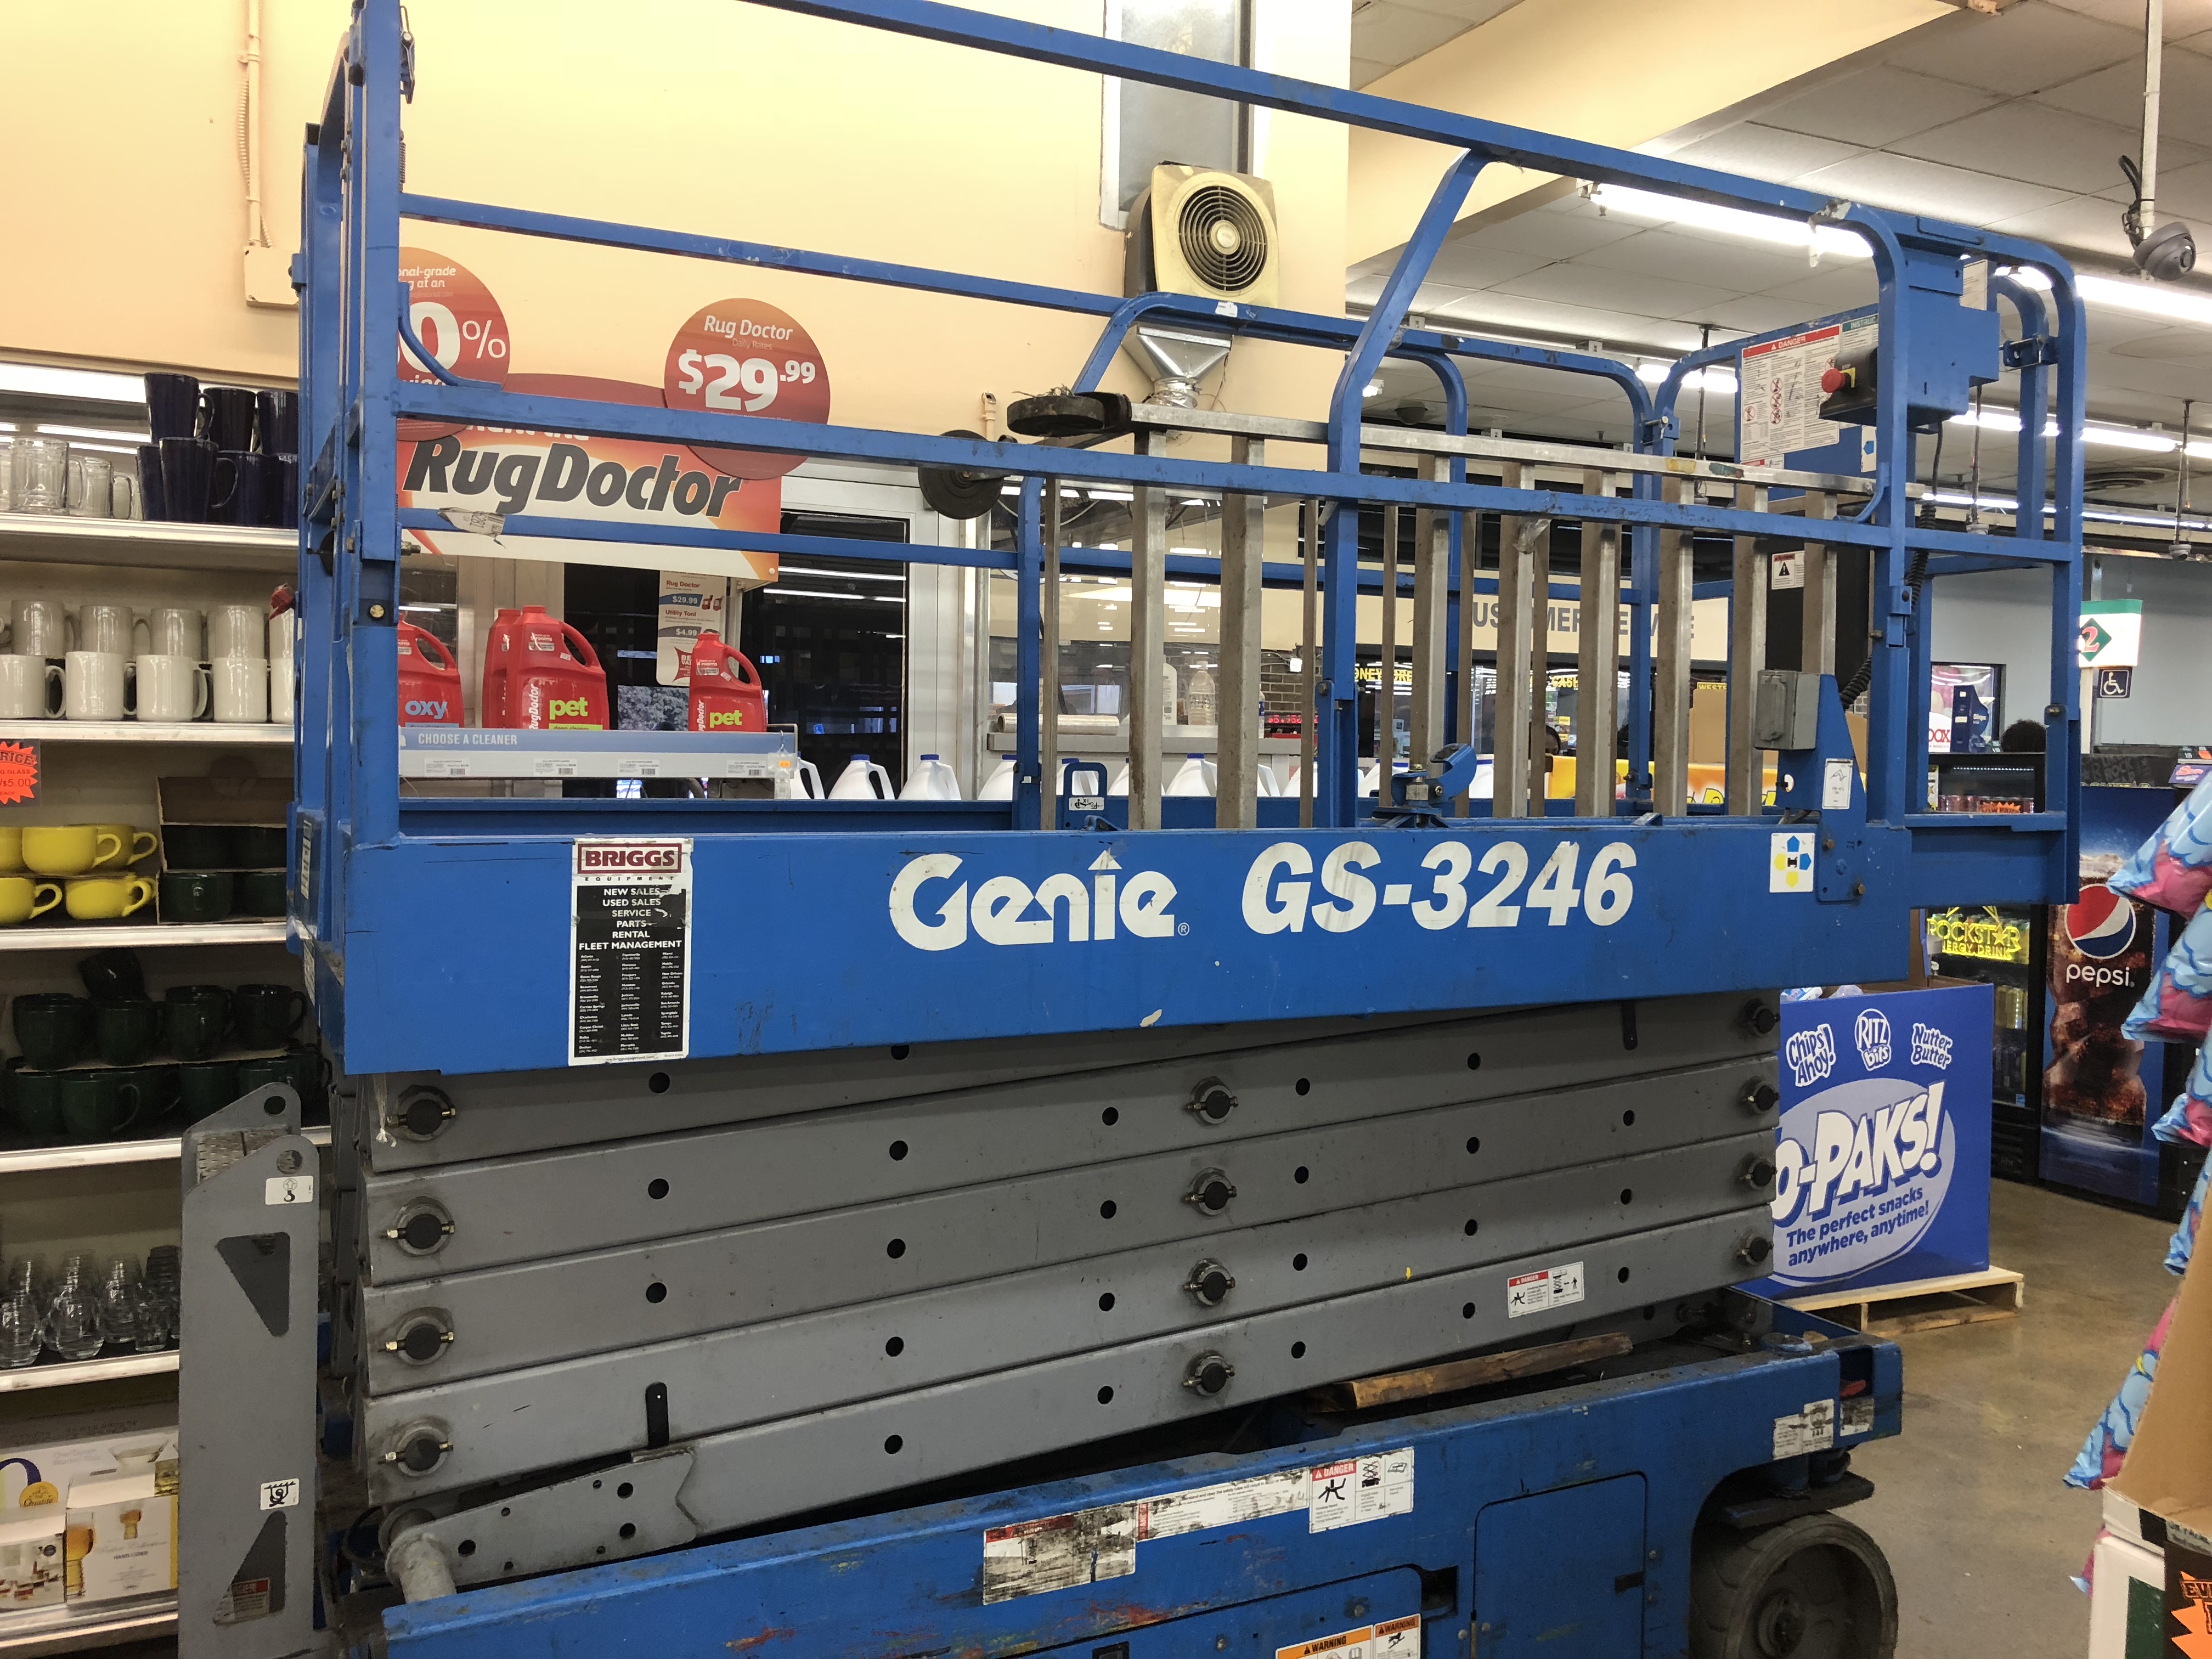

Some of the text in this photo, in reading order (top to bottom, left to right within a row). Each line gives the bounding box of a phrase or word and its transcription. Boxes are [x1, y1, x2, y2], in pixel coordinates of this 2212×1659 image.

[417, 279, 428, 287] at
[704, 315, 793, 340] Rug Doctor
[1850, 314, 1878, 329] INSTRUC
[398, 302, 506, 373] 0%
[732, 338, 772, 351] Daily Rates
[1778, 336, 1806, 348] DANGER
[678, 349, 816, 412] $29.99
[403, 437, 741, 517] RugDoctor
[672, 595, 698, 604] $29.99
[675, 628, 698, 636] $4.99
[2082, 626, 2100, 653] 2
[405, 701, 448, 720] oxy
[550, 697, 588, 720] pet
[697, 699, 706, 731] ugDoctor
[710, 710, 742, 729] pet
[419, 733, 517, 745] CHOOSE A CLEANER
[0, 751, 33, 765] RICE
[585, 850, 675, 867] BRIGGS
[1242, 841, 1637, 934] GS-3246
[889, 850, 1177, 951] Genie
[612, 940, 682, 949] MANAGEMENT
[1943, 939, 2011, 958] ERGY DRINK
[2066, 964, 2130, 987] pepsi
[1858, 1015, 1888, 1050] RITZ
[1913, 1024, 1953, 1052] Nutter
[1789, 1032, 1824, 1062] Chips
[1864, 1045, 1891, 1068] bits
[1912, 1045, 1951, 1068] Butter
[1771, 1081, 1945, 1221] O-PAKS!
[1786, 1186, 1923, 1248] The perfect snacks
[1788, 1200, 1929, 1266] anywhere, anytime!
[1521, 1274, 1539, 1283] DANGER
[1324, 1463, 1353, 1477] DANGER
[1385, 1618, 1415, 1633] WARNING
[1312, 1636, 1346, 1652] WARNING
